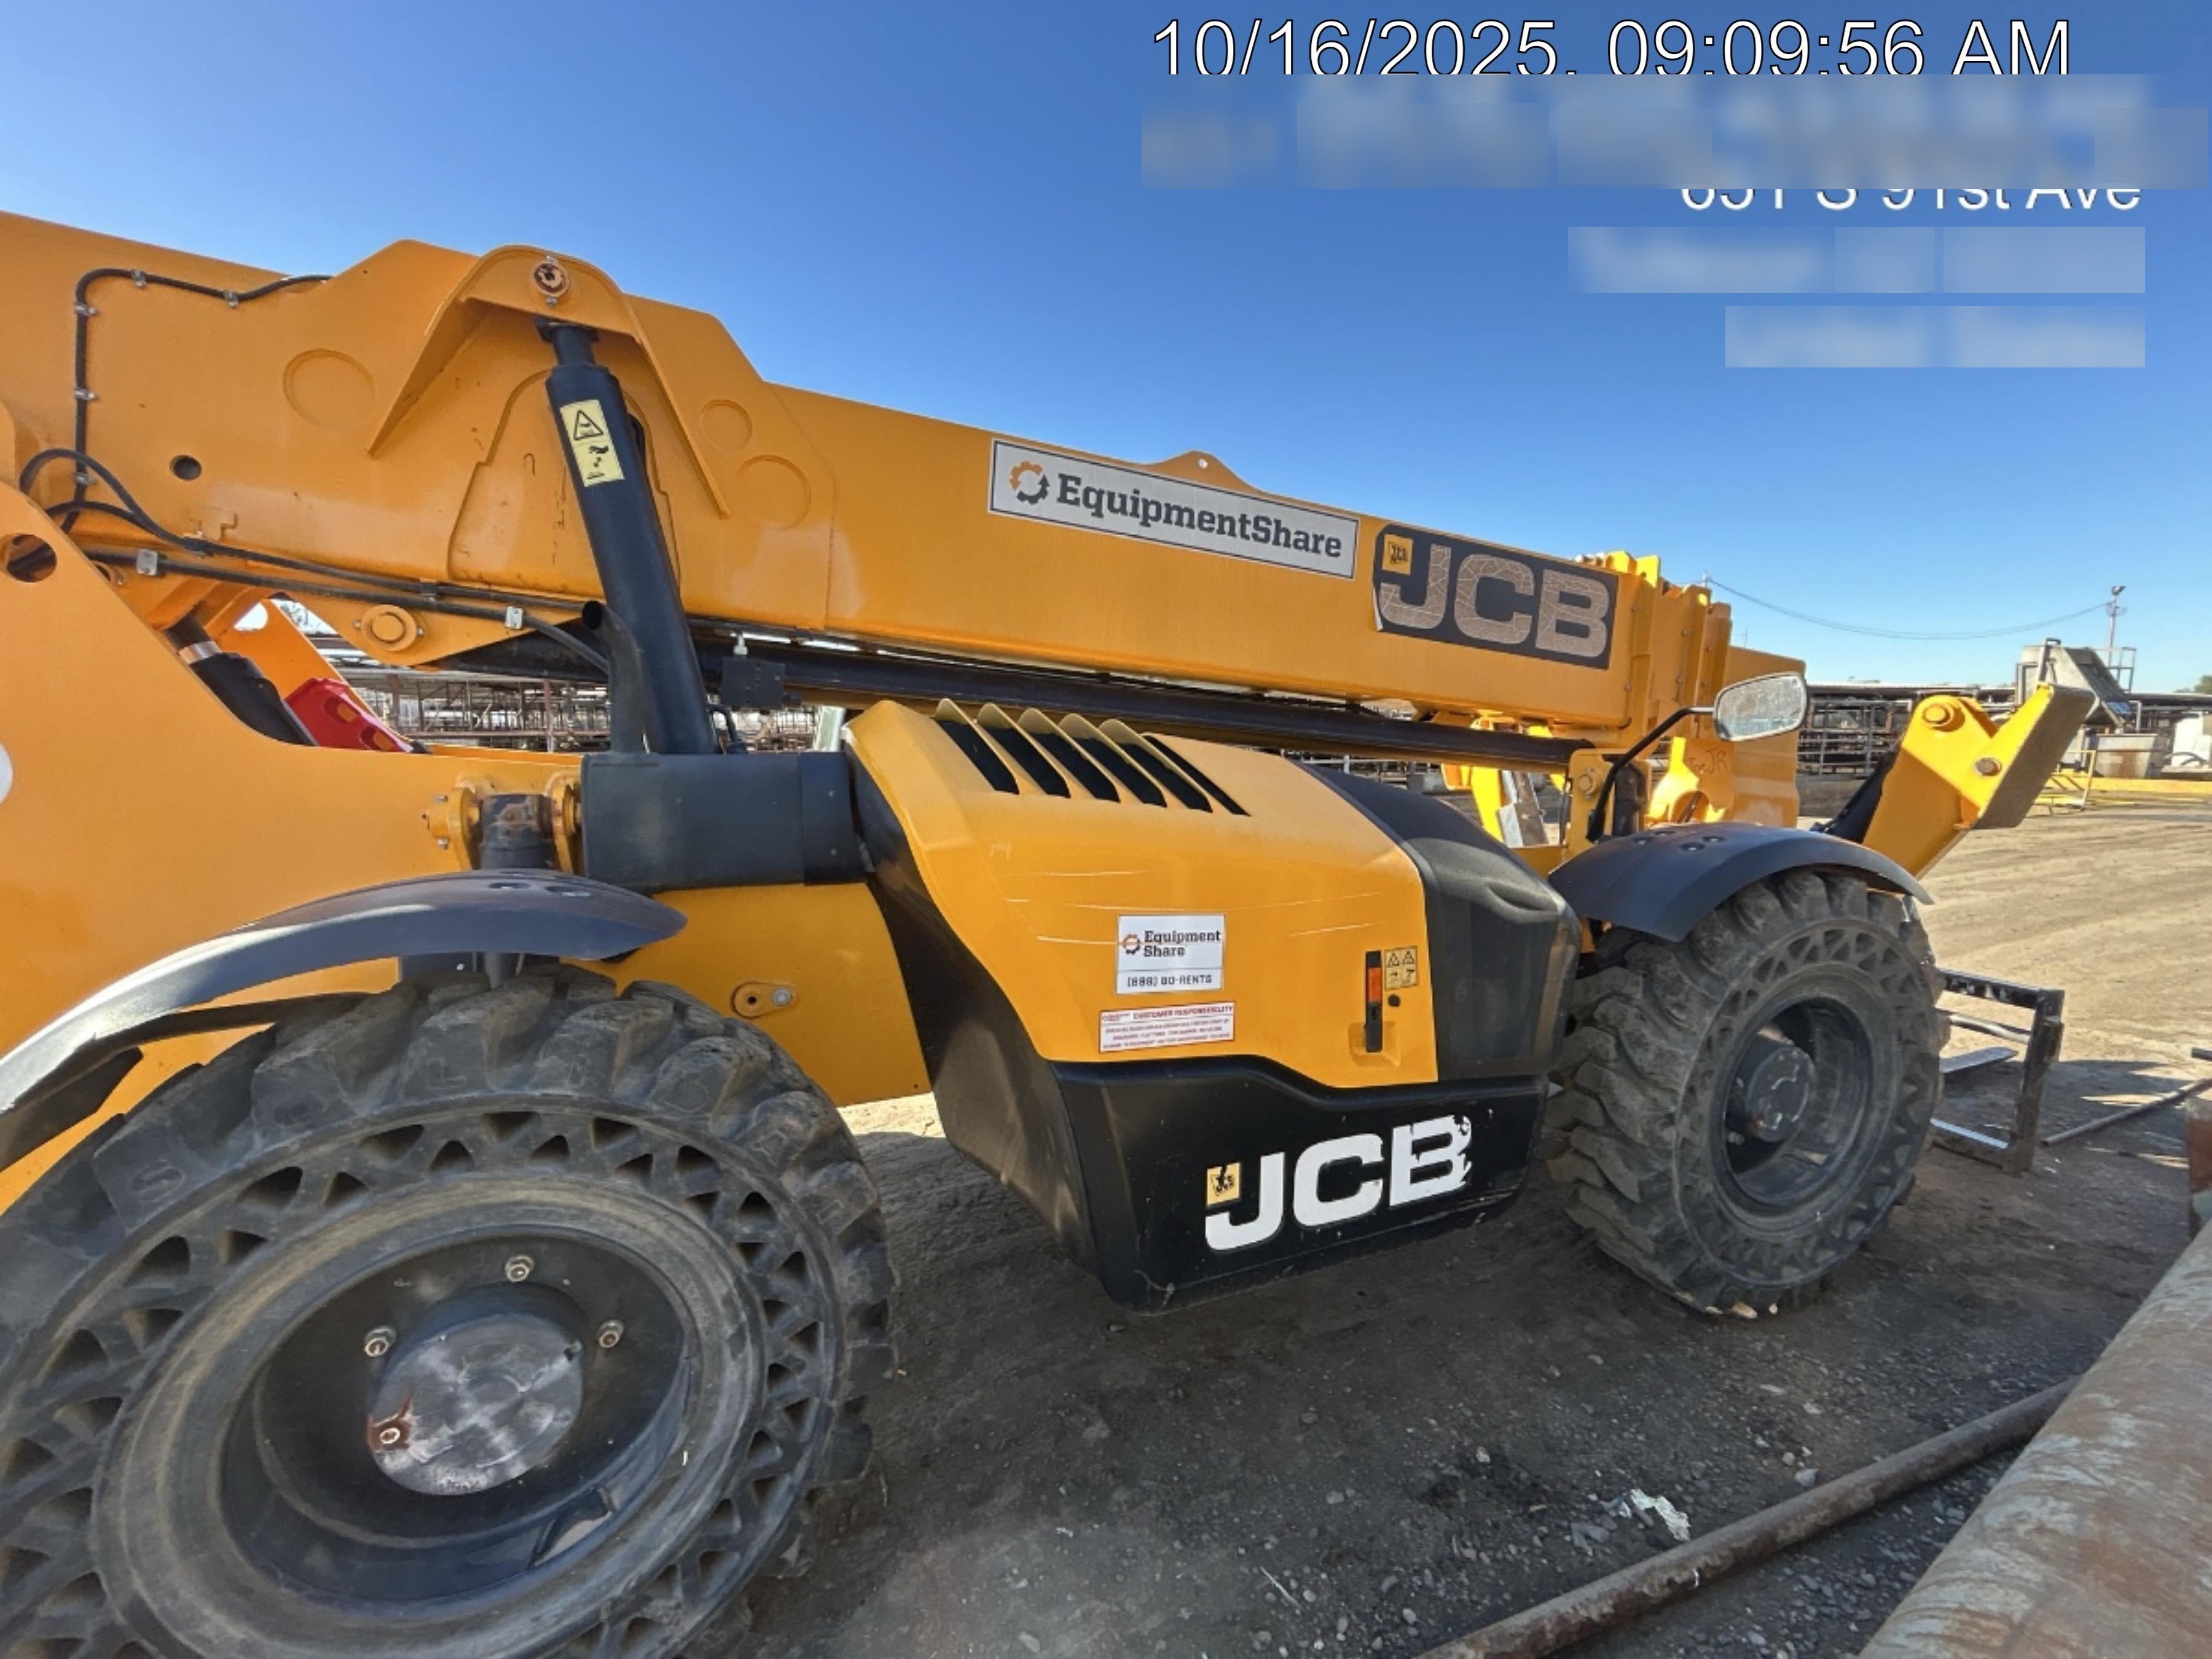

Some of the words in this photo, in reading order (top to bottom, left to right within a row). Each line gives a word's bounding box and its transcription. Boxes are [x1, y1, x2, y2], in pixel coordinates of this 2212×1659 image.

[1057, 473, 1343, 558] EquipmentShare
[1379, 544, 1610, 659] JCB
[1143, 930, 1222, 944] Equipment
[1143, 944, 1186, 957] Share
[1205, 1115, 1472, 1251] JCB
